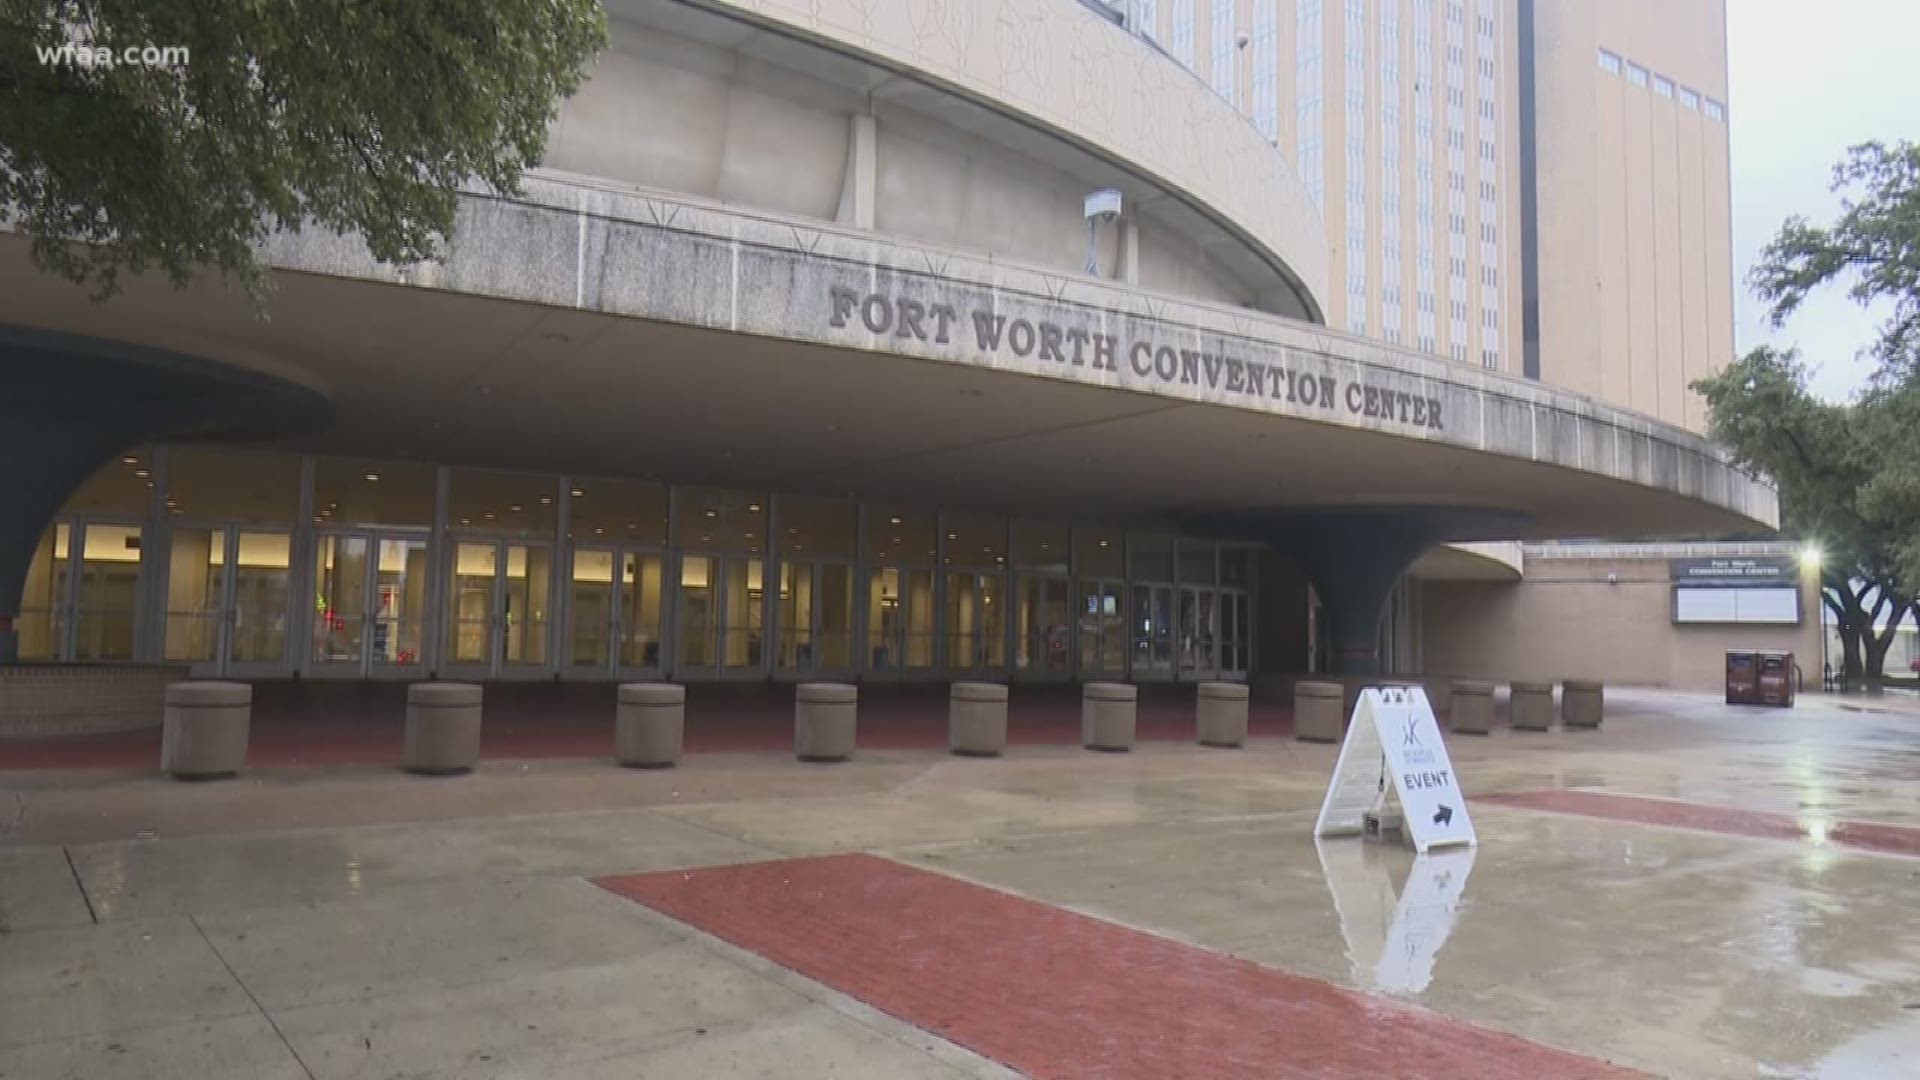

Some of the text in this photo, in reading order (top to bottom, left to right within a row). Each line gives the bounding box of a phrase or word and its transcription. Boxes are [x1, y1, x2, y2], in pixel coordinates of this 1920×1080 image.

[830, 287, 1444, 430] FORT WORTH CONVENTION CENTER
[1404, 770, 1449, 790] EVENT
